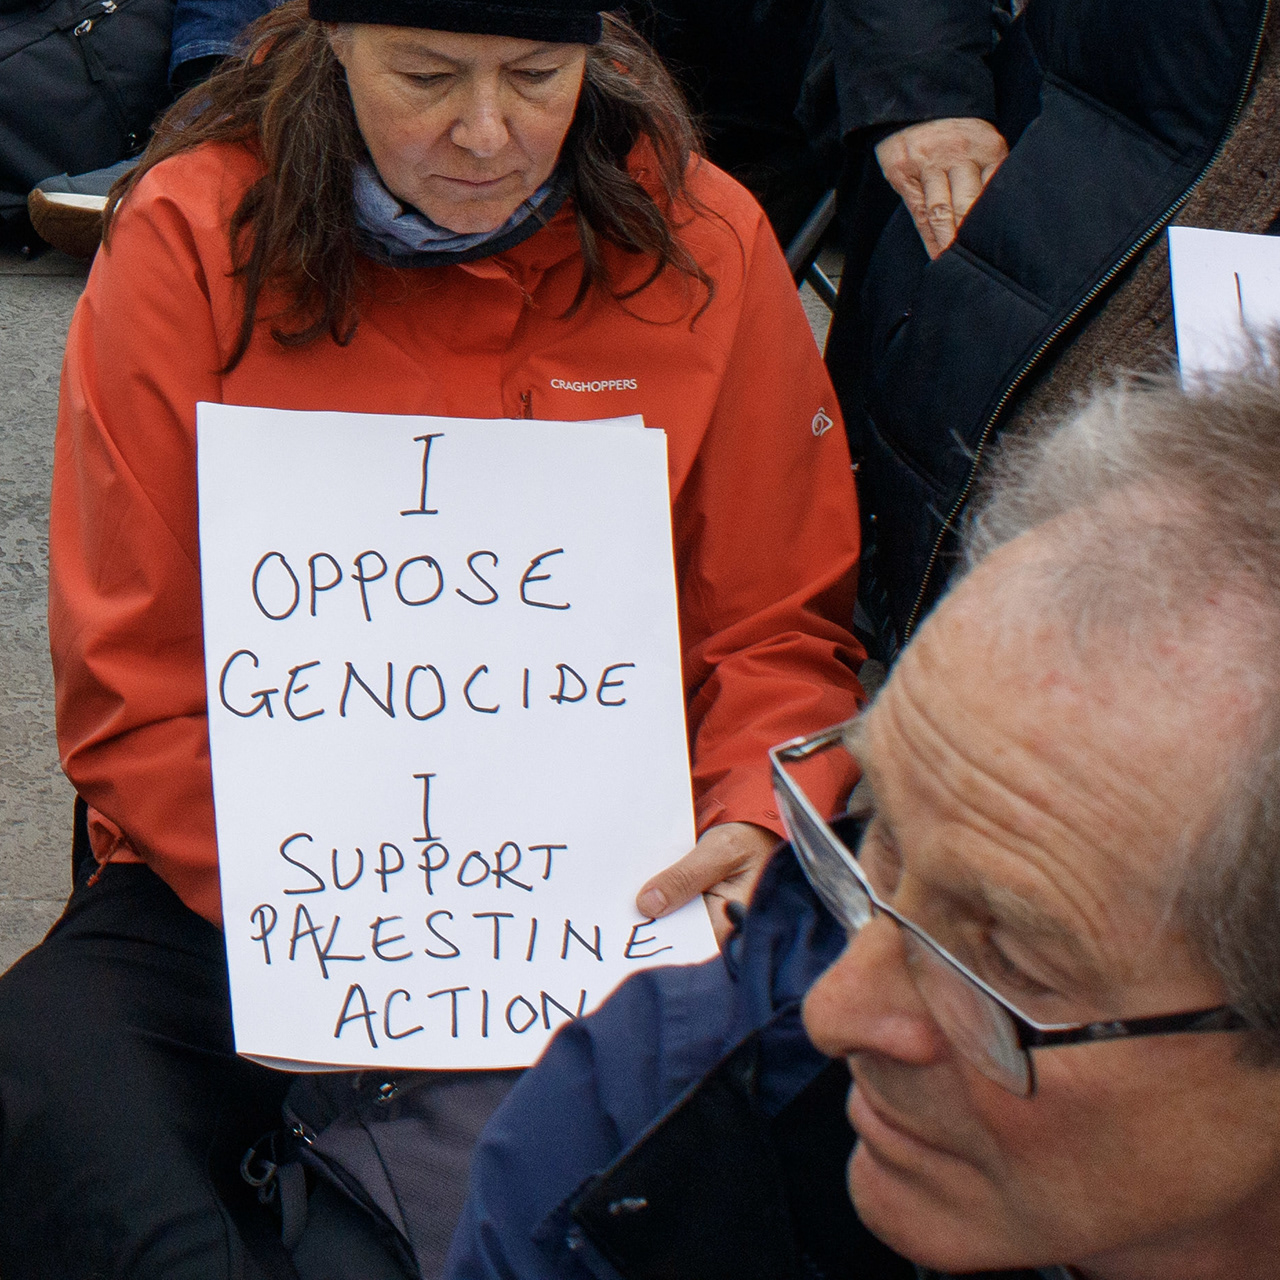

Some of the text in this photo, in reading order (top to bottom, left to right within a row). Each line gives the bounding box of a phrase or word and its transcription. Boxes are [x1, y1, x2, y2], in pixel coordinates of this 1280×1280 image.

[551, 378, 638, 391] CRAGHOPPERS
[399, 433, 445, 517] I
[251, 548, 571, 622] OPPOSE
[218, 649, 636, 722] GENOCIDE
[412, 772, 438, 843] I
[279, 832, 568, 896] SUPPORT
[249, 903, 674, 980] PALESTINE
[333, 983, 587, 1049] ACTION
